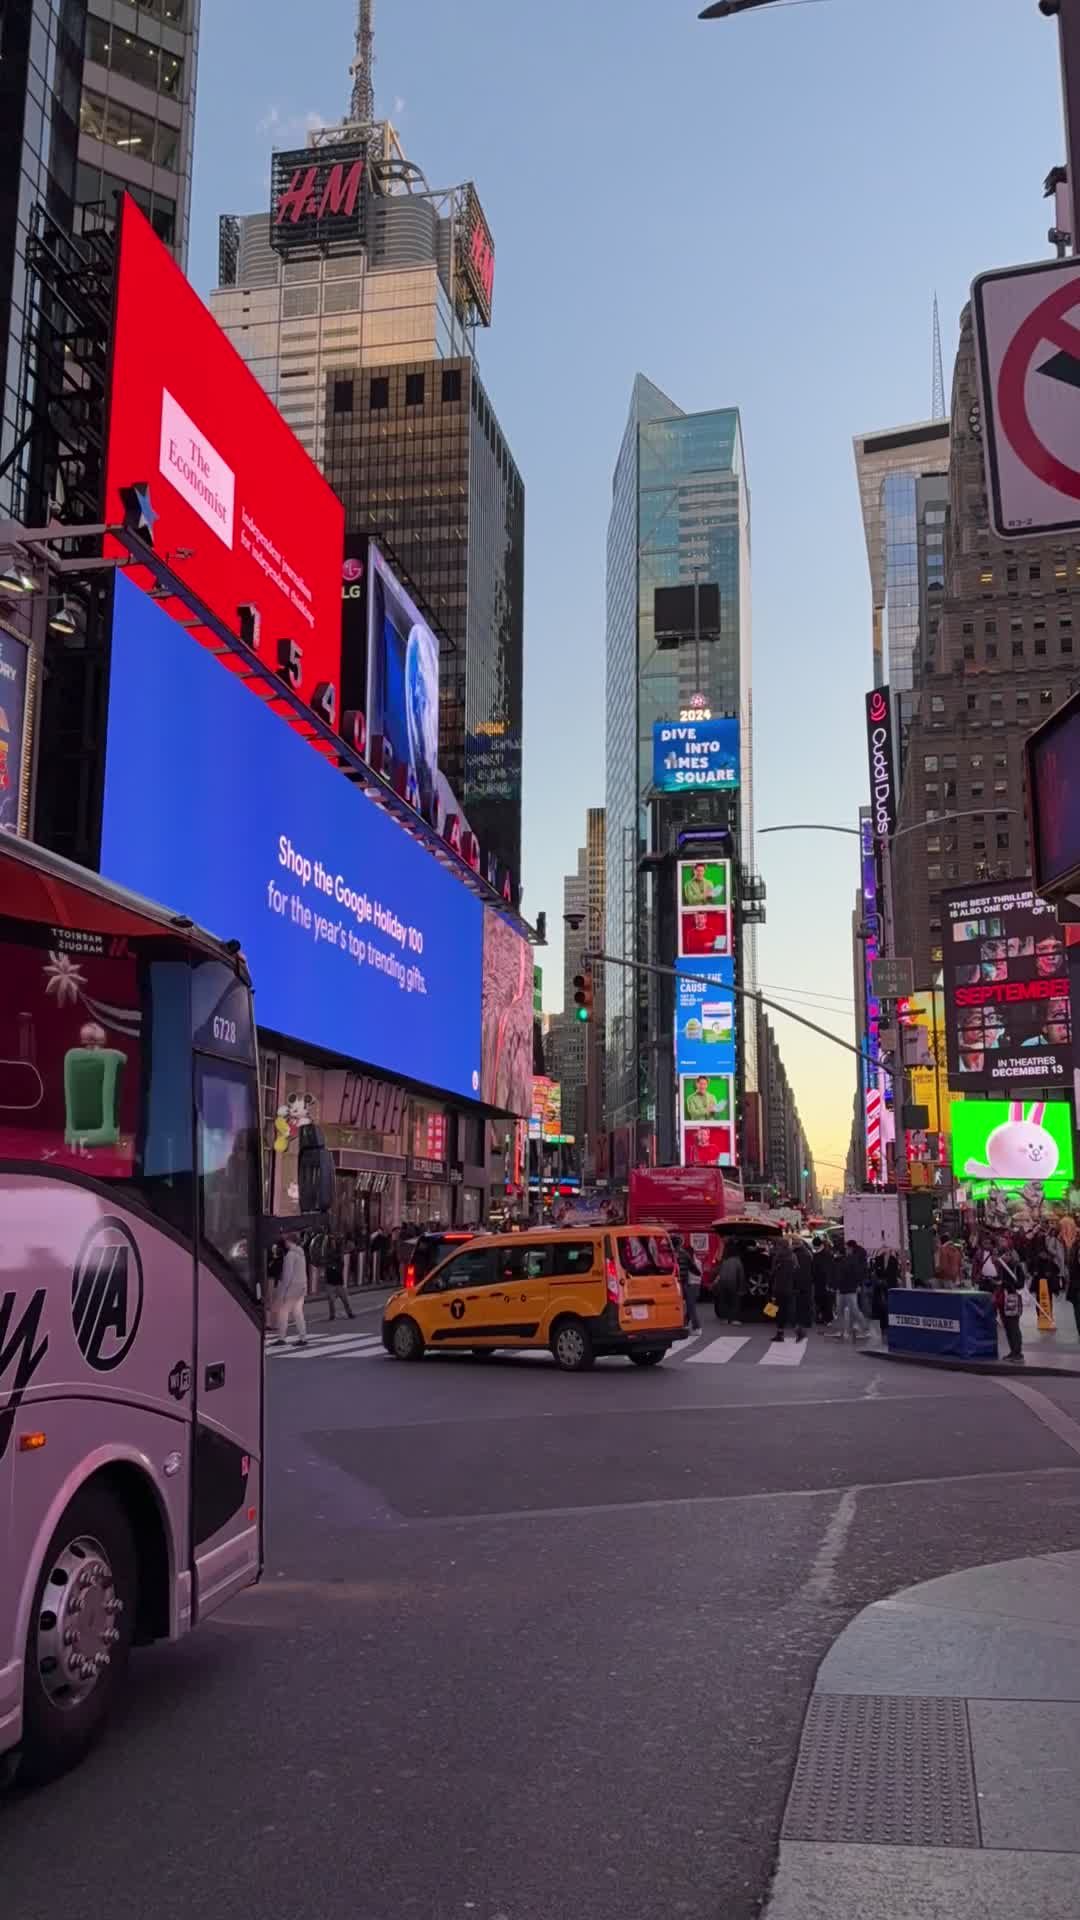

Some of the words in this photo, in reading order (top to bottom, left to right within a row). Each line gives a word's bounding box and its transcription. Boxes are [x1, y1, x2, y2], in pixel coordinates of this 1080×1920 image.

[275, 160, 364, 225] H&M
[189, 439, 210, 479] The
[168, 438, 227, 524] Economist
[342, 585, 361, 599] LG
[680, 709, 712, 722] 2024
[661, 728, 696, 741] DIVE
[685, 741, 720, 754] INTO
[872, 727, 889, 783] Cuddl
[664, 752, 709, 769] TIMES
[675, 769, 735, 783] SQUARE
[874, 783, 892, 834] Duds
[279, 835, 311, 887] Shop
[313, 861, 333, 896] the
[335, 875, 372, 923] Google
[374, 901, 407, 949] Holiday
[408, 926, 423, 954] 100
[969, 896, 991, 907] BEST
[992, 891, 1034, 903] THRILLER
[960, 907, 981, 917] ALSO
[983, 904, 1001, 913] ONE
[1002, 902, 1014, 911] OF
[1016, 899, 1034, 908] THE
[1031, 907, 1044, 915] OF
[267, 879, 288, 916] for
[291, 895, 312, 929] the
[313, 912, 347, 950] year's
[348, 930, 366, 966] top
[367, 941, 405, 989] trending
[680, 983, 708, 993] CAUSE
[213, 1015, 236, 1044] 6728
[997, 1059, 1008, 1067] IN
[1009, 1056, 1056, 1066] THEATRES
[991, 1065, 1050, 1078] DECEMBER
[1051, 1064, 1064, 1074] 13
[895, 1315, 921, 1326] TIMES
[922, 1317, 954, 1329] SQUARE
